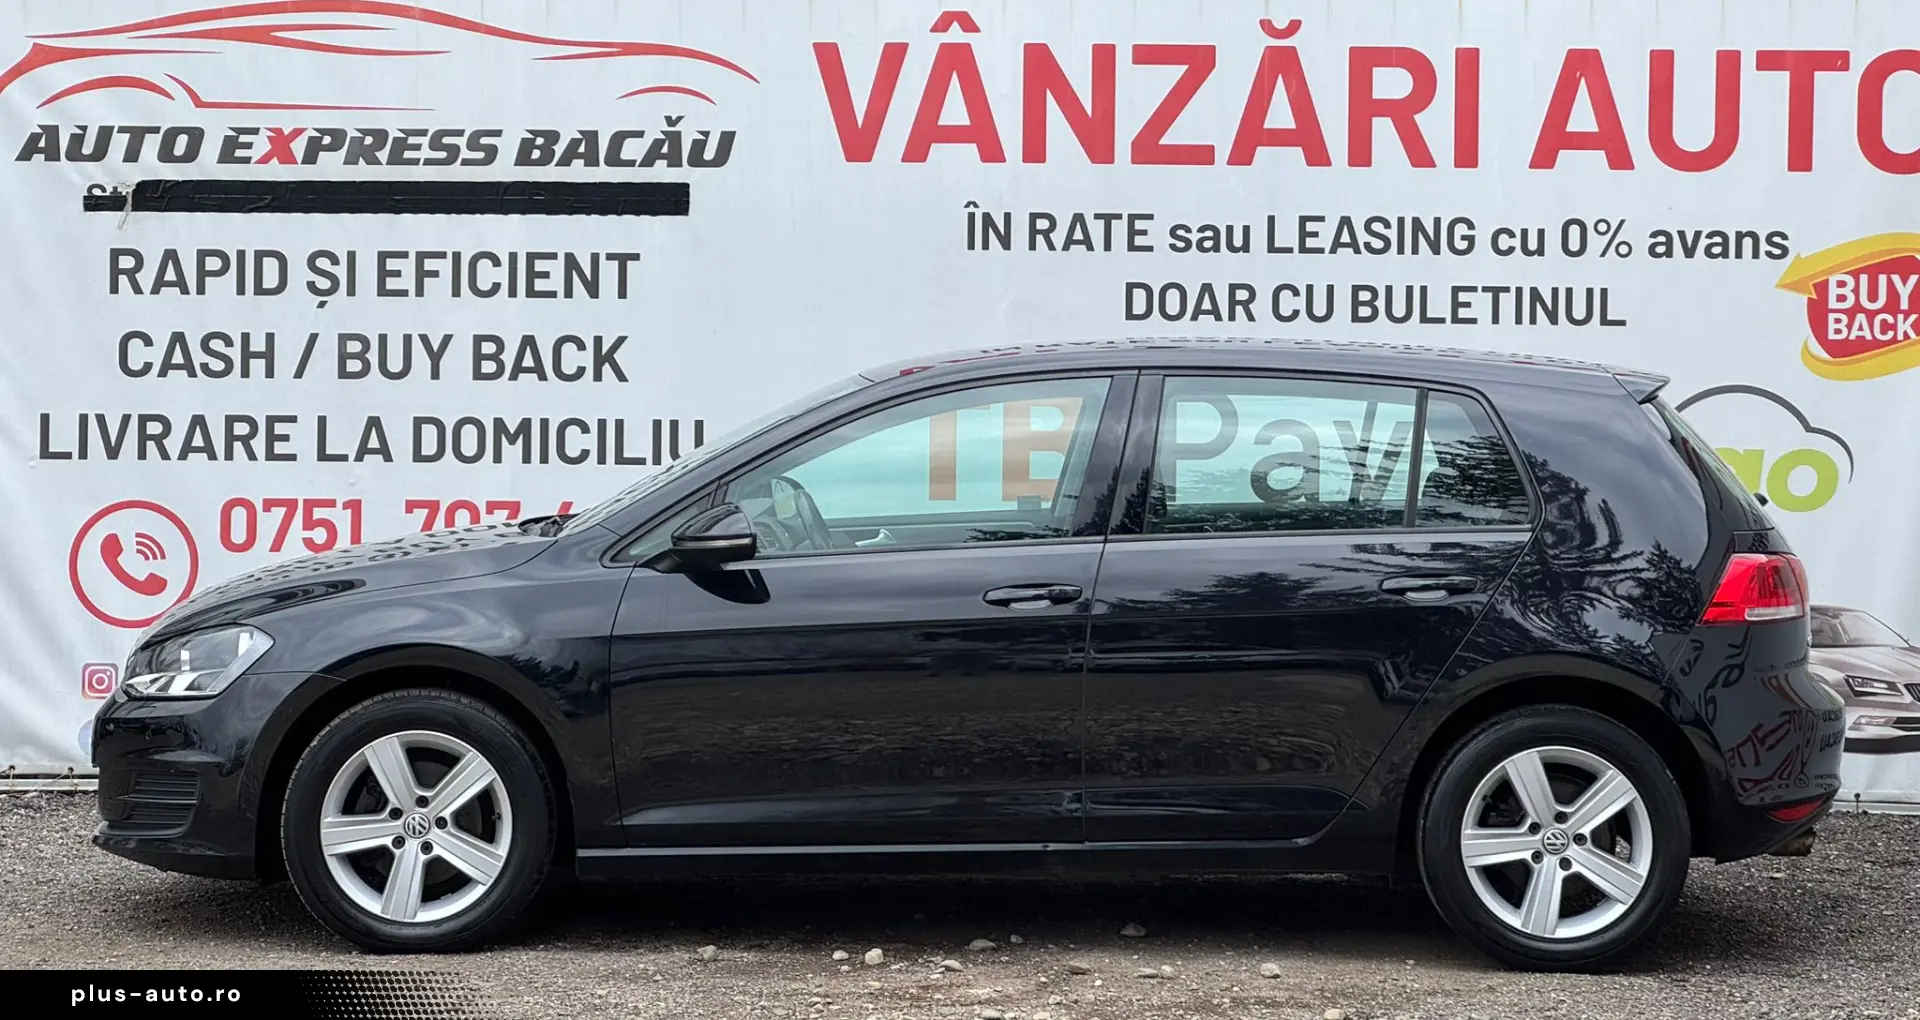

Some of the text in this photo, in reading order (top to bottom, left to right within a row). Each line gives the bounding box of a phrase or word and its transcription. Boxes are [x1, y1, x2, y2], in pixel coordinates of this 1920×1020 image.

[812, 11, 1920, 175] VÂNZĂRI AUTO
[14, 115, 738, 169] AUTO EXPRESS BACĂU
[963, 200, 1790, 261] ÎN RATE sau LEASING cu 0% avans
[109, 247, 641, 309] RAPID ȘI EFICIENT
[1124, 281, 1627, 328] DOAR CU BULETINUL
[1827, 273, 1920, 310] BUY
[1827, 312, 1919, 341] BACK
[118, 329, 630, 384] CASH / BUY BACK
[39, 412, 704, 466] LIVRARE LA DOMICILIU
[219, 497, 363, 555] 0751
